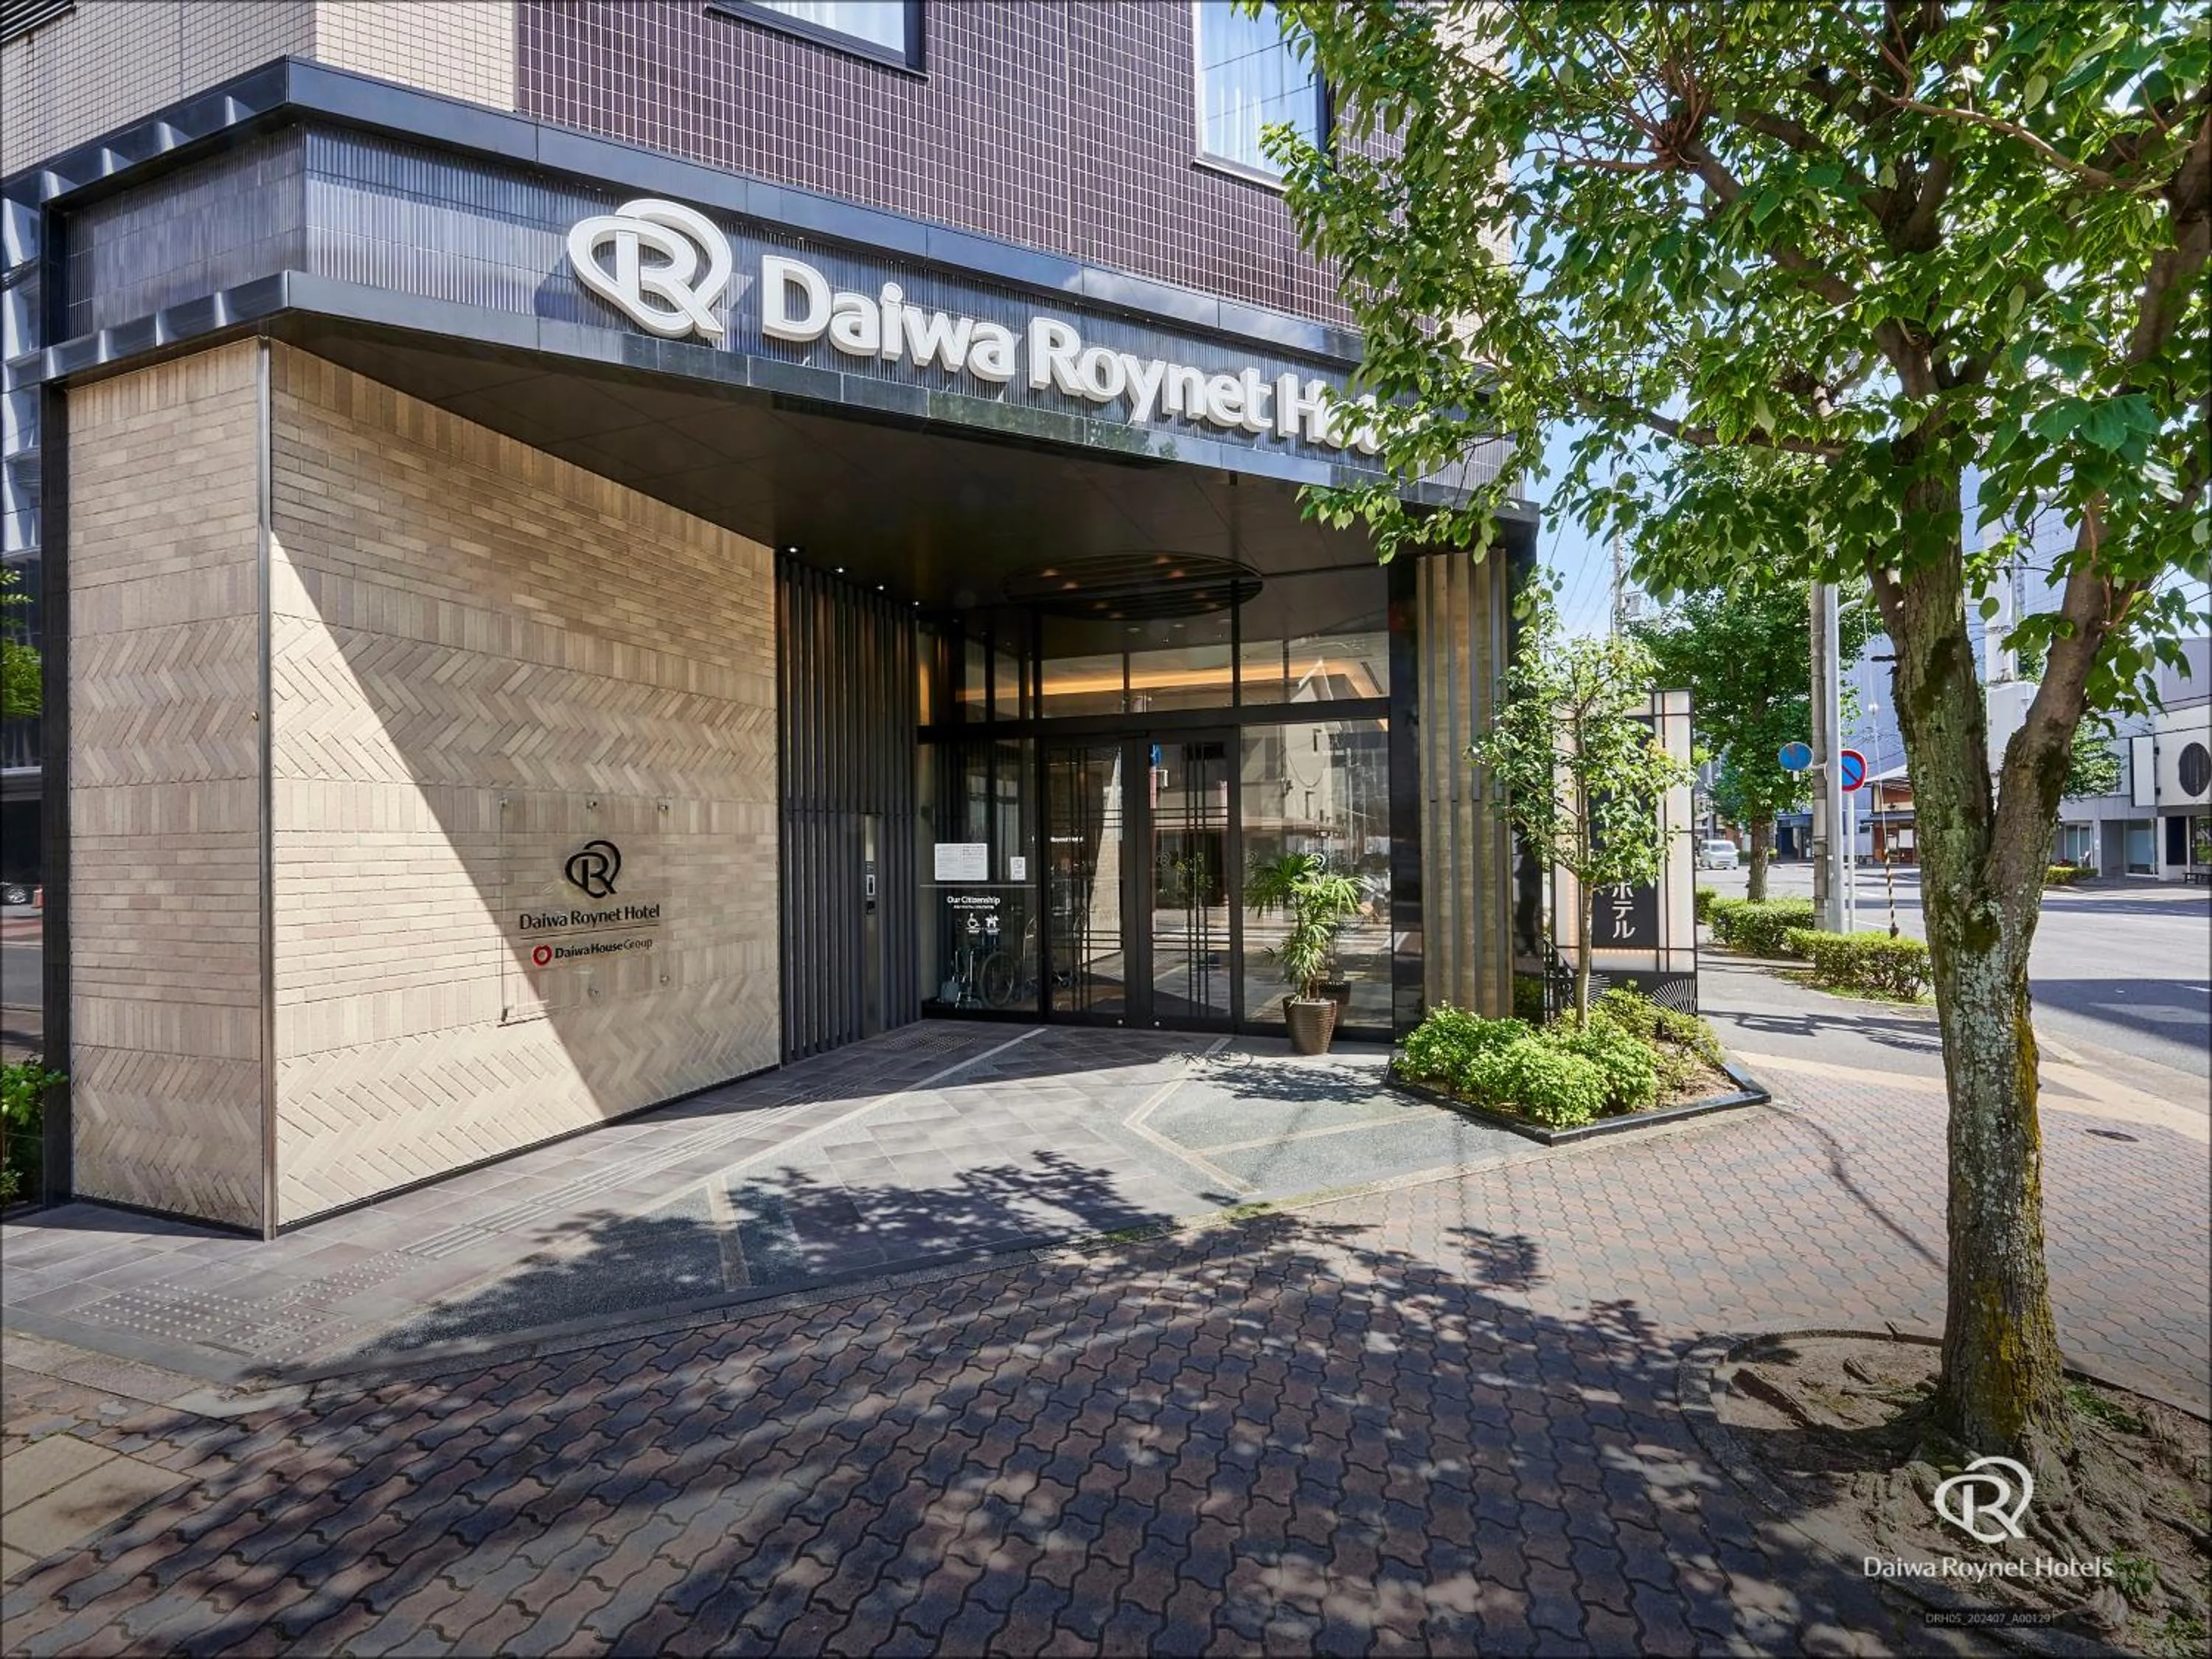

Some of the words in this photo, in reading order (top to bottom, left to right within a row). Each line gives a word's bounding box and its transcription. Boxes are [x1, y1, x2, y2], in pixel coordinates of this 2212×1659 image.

[762, 254, 1016, 383] Daiwa
[1028, 316, 1273, 434] Roynet
[946, 895, 961, 904] Our
[519, 913, 568, 930] Daiwa
[570, 908, 623, 928] Roynet
[625, 903, 660, 920] Hotel
